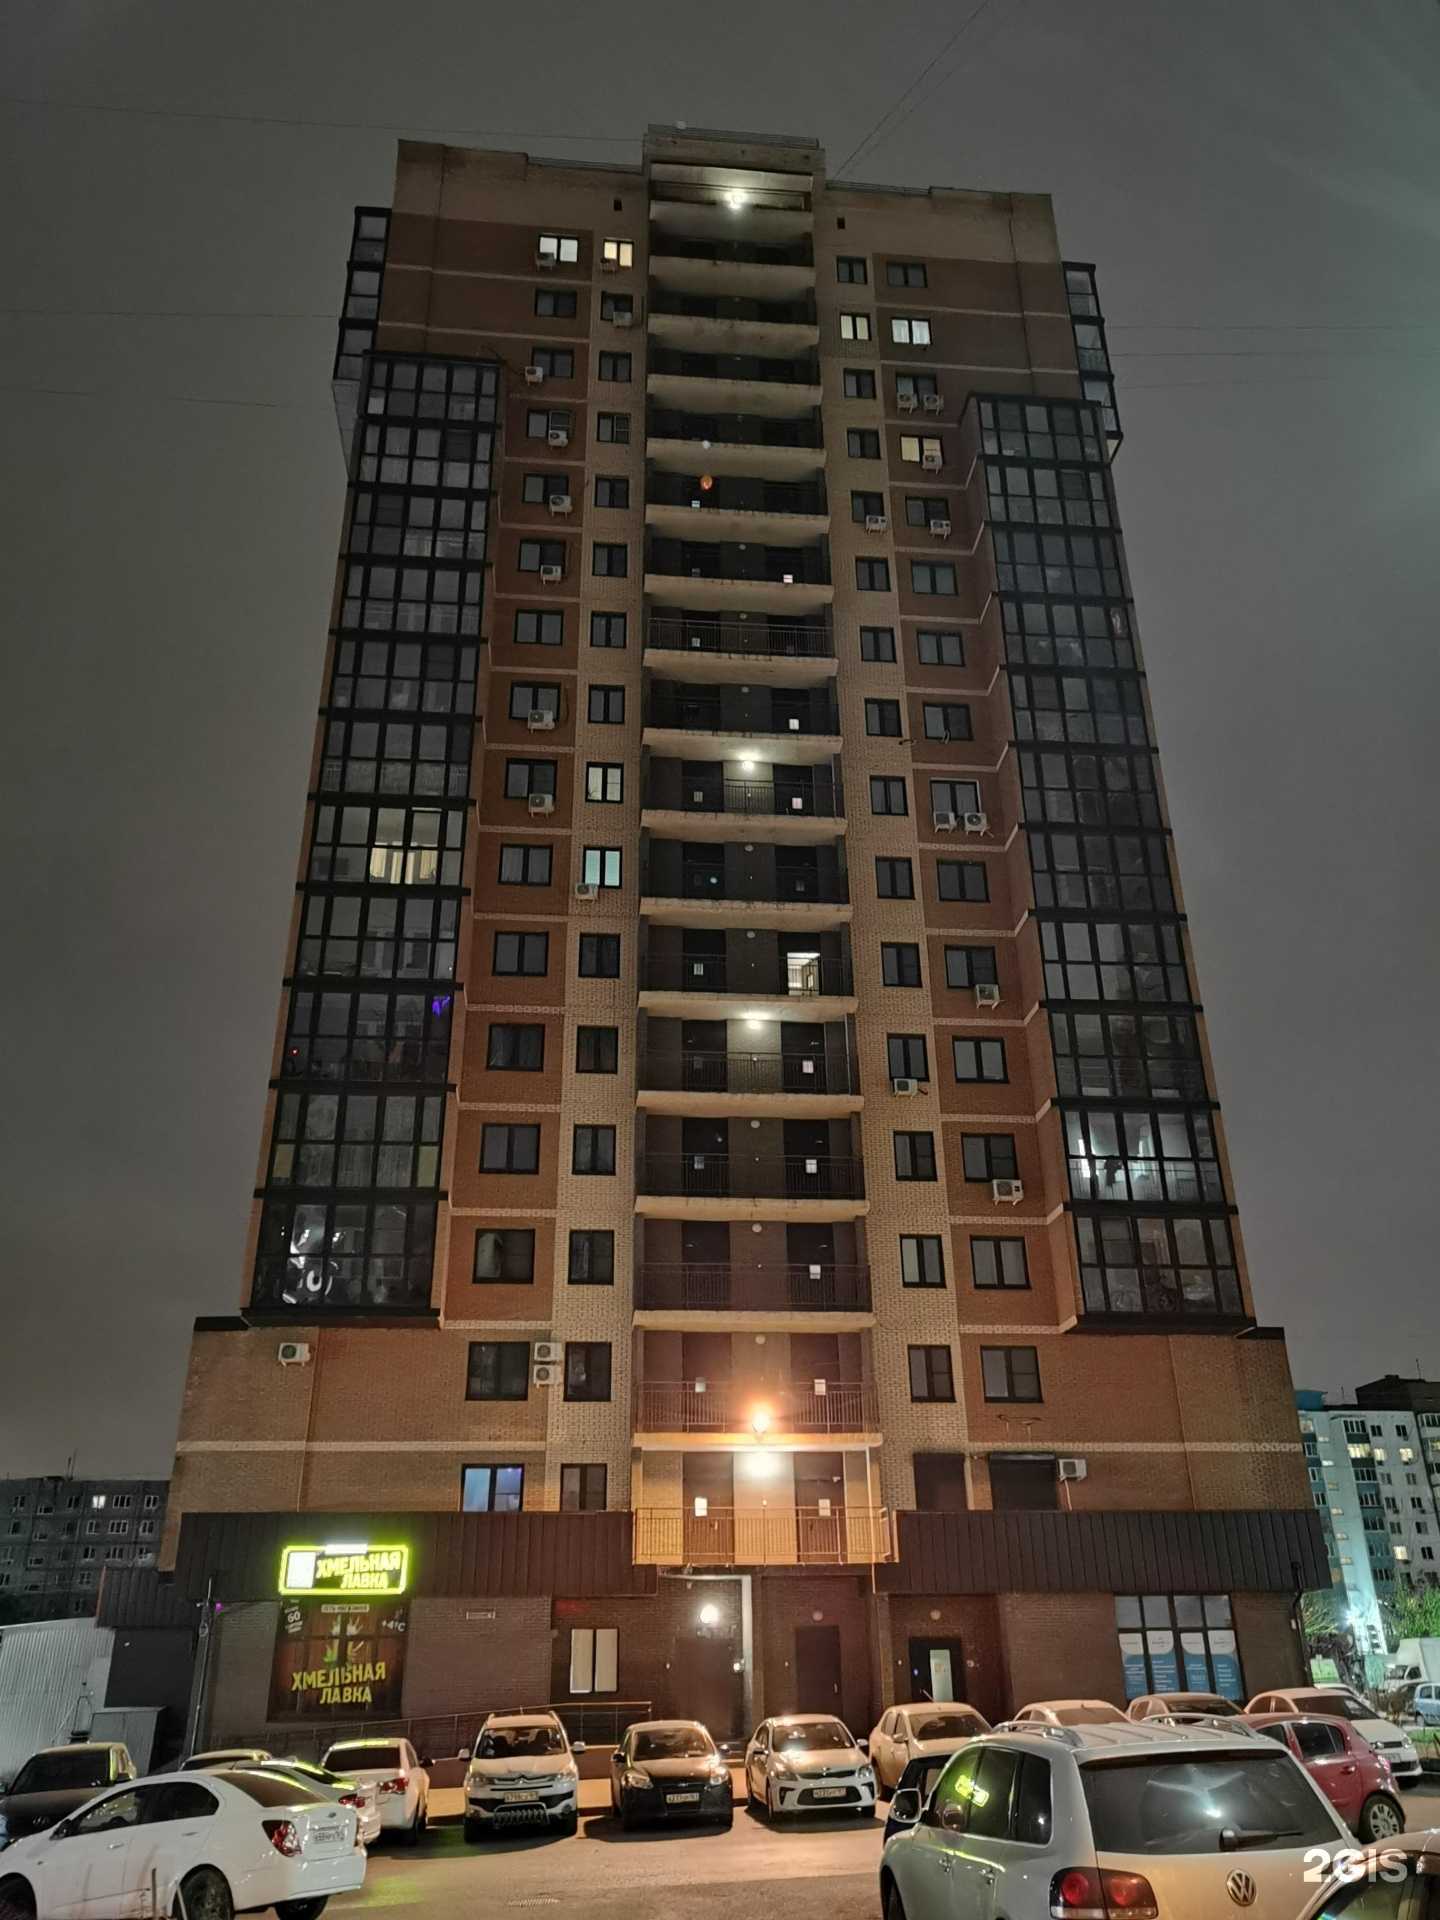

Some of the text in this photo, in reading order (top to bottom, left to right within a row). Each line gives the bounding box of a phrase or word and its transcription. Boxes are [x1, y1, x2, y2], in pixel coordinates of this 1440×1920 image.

[316, 1551, 401, 1579] ХМЕЛЬНАЯ
[340, 1572, 388, 1589] ЛАВКА
[291, 1661, 386, 1692] ХМЕЛЬНАЯ
[320, 1686, 372, 1705] ЛАВКА
